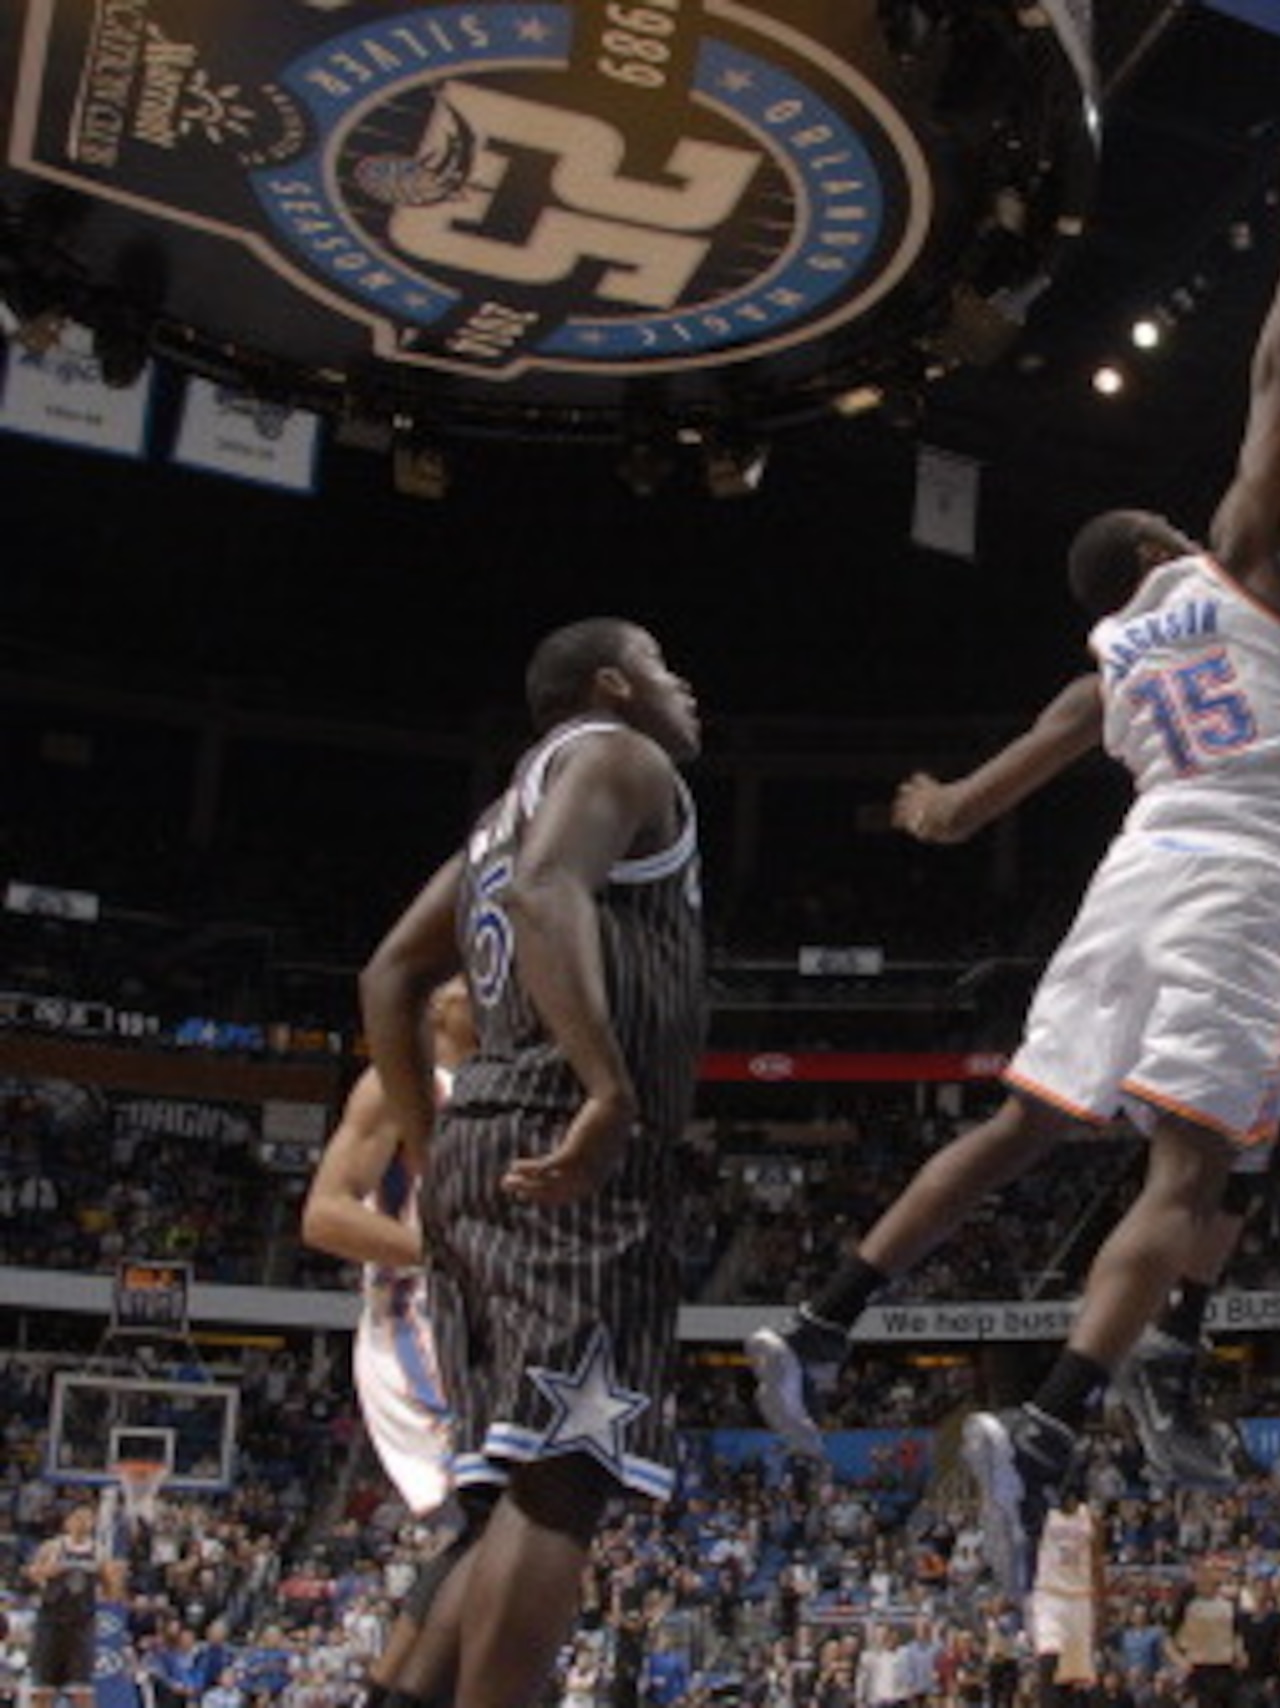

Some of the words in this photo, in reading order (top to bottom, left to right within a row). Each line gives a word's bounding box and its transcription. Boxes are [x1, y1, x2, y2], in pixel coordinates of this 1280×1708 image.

[304, 13, 490, 97] SILVER
[267, 179, 397, 292] SEASON
[386, 78, 766, 311] 25
[763, 99, 868, 272] ORLANDO
[640, 286, 804, 347] MAGIC
[1124, 645, 1259, 781] 15
[882, 1311, 926, 1334] We
[934, 1307, 995, 1342] help
